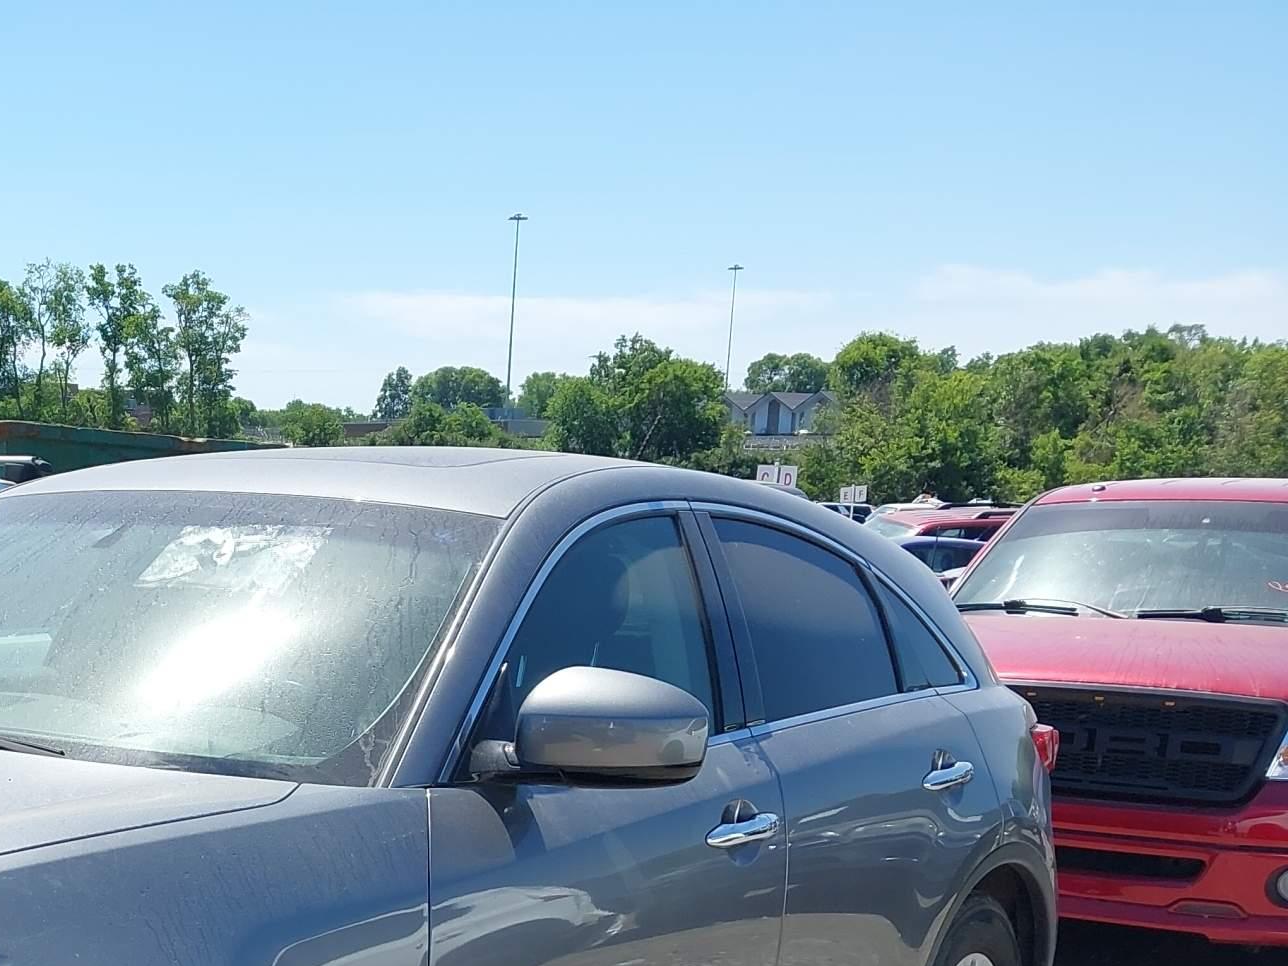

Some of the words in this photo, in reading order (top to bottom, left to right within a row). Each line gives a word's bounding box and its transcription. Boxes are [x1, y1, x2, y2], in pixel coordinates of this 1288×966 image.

[784, 472, 792, 486] D
[843, 491, 849, 500] E
[858, 490, 864, 499] F
